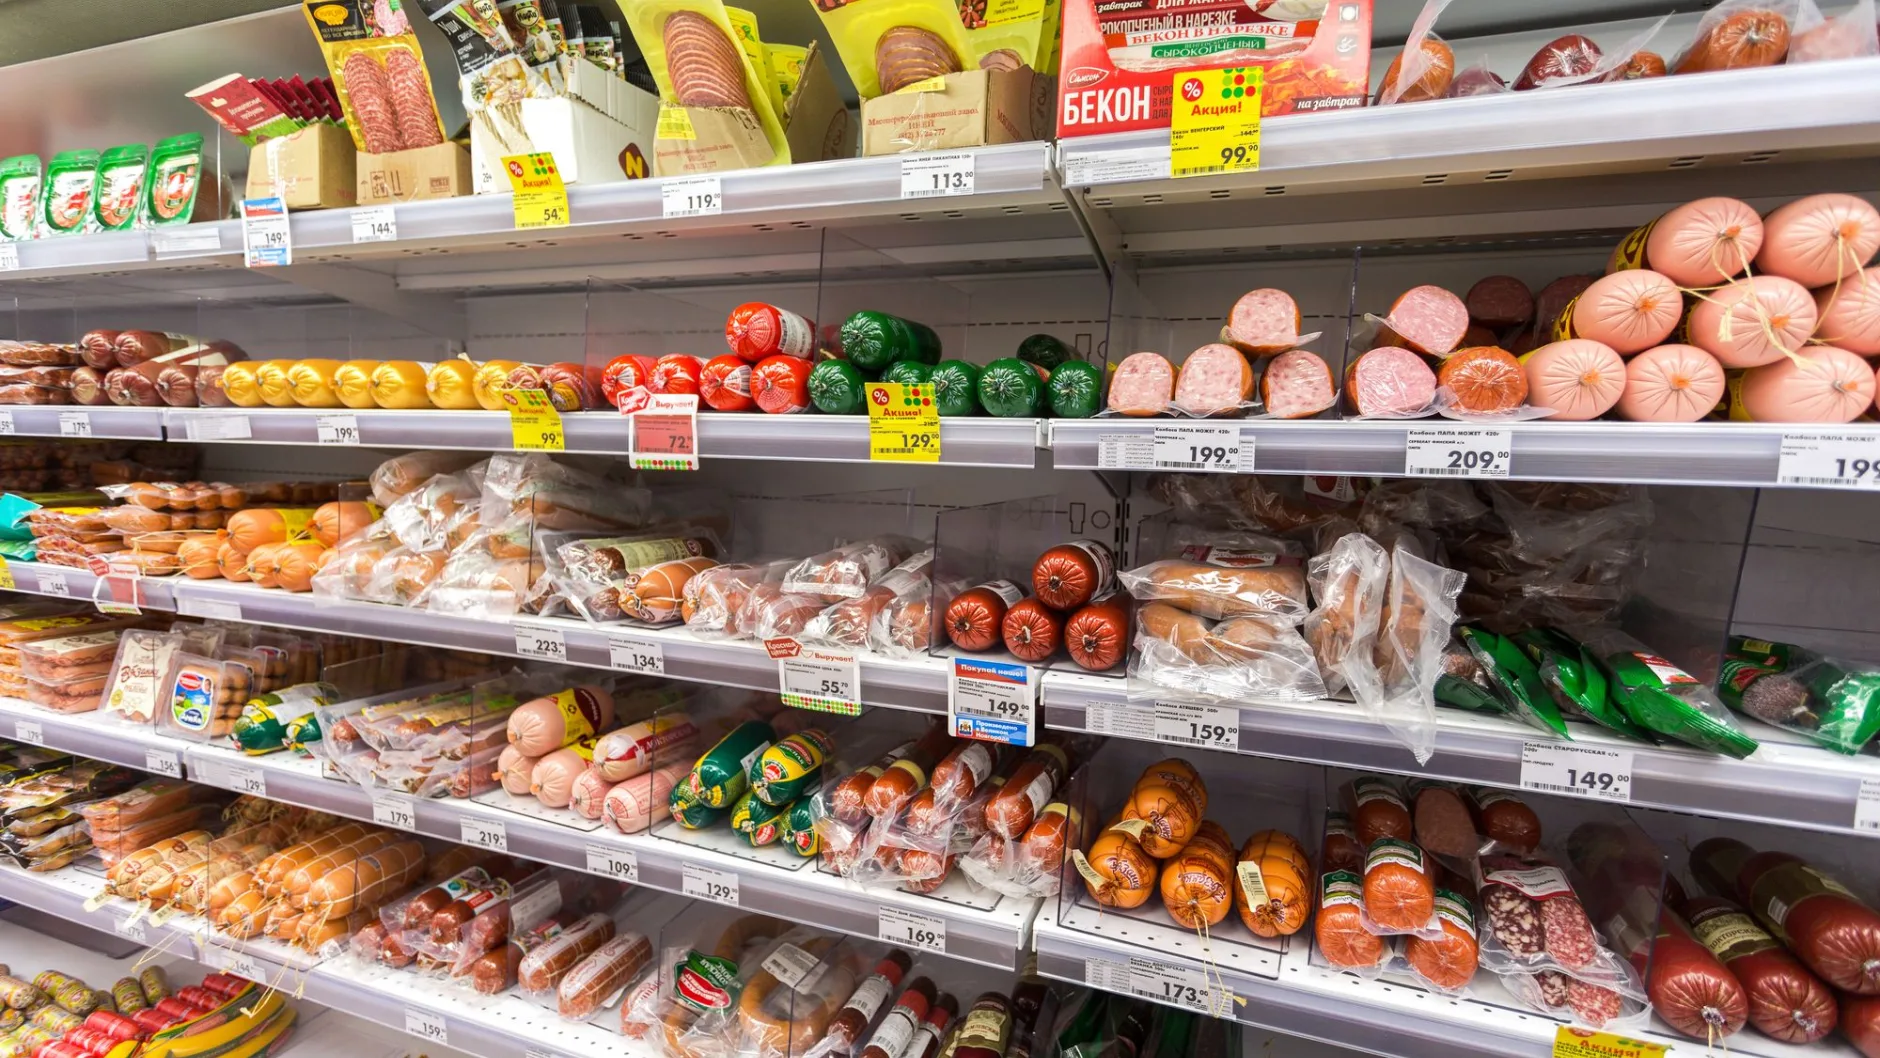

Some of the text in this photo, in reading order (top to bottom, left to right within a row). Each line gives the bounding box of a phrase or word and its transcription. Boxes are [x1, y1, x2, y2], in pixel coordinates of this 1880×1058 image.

[1186, 9, 1237, 28] НАРЕЗКЕ
[1132, 23, 1290, 44] БЕКОН В НАРЕЗКЕ
[1154, 37, 1261, 58] СЫРОКОПЧЕНЫЙ
[1069, 72, 1101, 85] Самсон
[1183, 80, 1202, 98] %
[1063, 85, 1151, 126] БЕКОН
[1191, 101, 1242, 117] Акция!
[1297, 95, 1362, 110] на завтрак
[522, 178, 553, 189] Акция!
[873, 390, 888, 403] %
[883, 407, 922, 417] Акция!
[766, 641, 797, 650] Красная
[769, 649, 789, 657] цена
[814, 652, 854, 664] Выручает!
[960, 663, 1023, 678] Покупай наше!
[975, 719, 1018, 732] Произведено
[980, 726, 1009, 737] Великом
[975, 732, 1010, 742] Новгороде
[1579, 1039, 1641, 1057] Акция!
